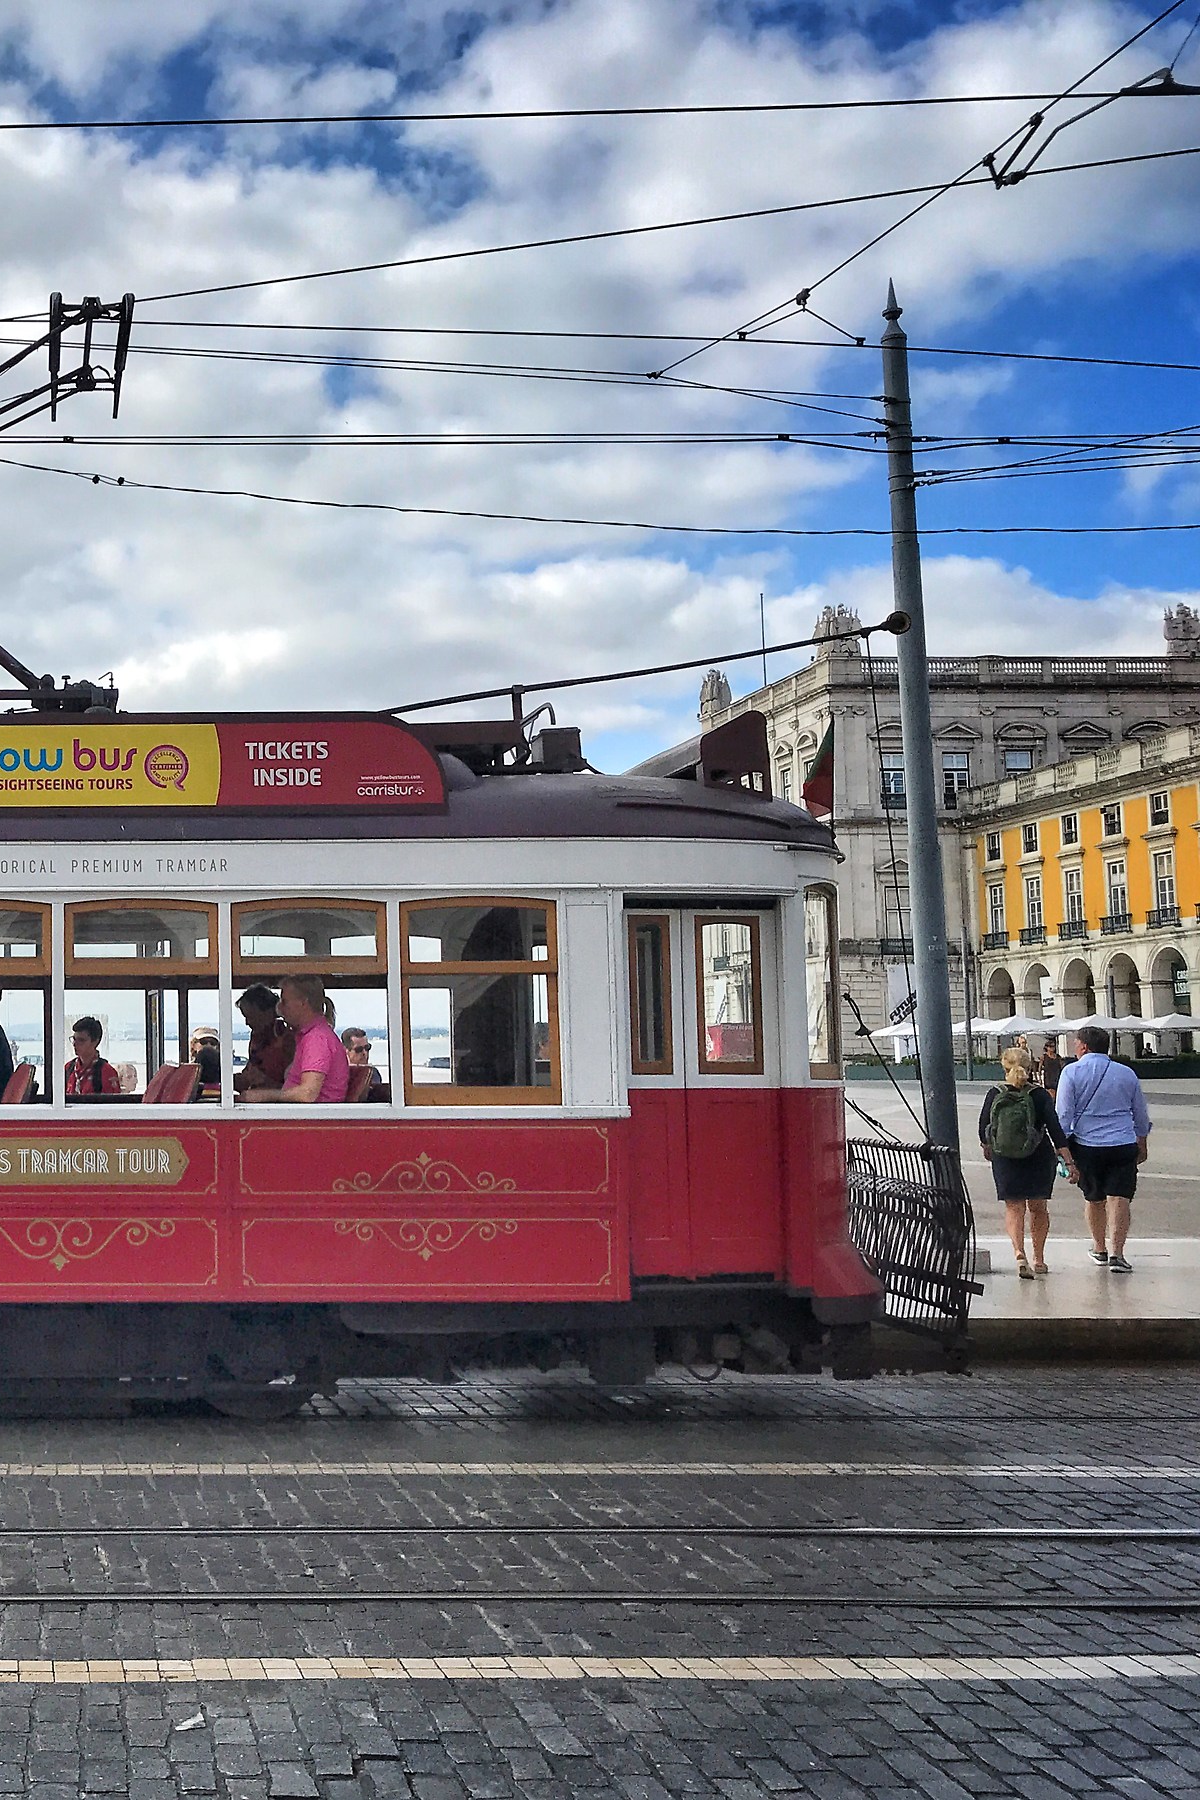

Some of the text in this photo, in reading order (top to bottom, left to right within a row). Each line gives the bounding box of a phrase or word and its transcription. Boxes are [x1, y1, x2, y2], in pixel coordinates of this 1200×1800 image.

[73, 738, 138, 772] bus
[152, 751, 181, 763] EXCELLENCE
[244, 741, 329, 760] TICKETS
[88, 778, 133, 790] TOURS
[253, 768, 322, 787] INSIDE
[357, 784, 414, 796] carristur
[71, 859, 143, 873] PREMIUM
[156, 858, 228, 872] TRAMCAR
[17, 1149, 109, 1173] TRAMCAR
[115, 1148, 171, 1173] TOUR
